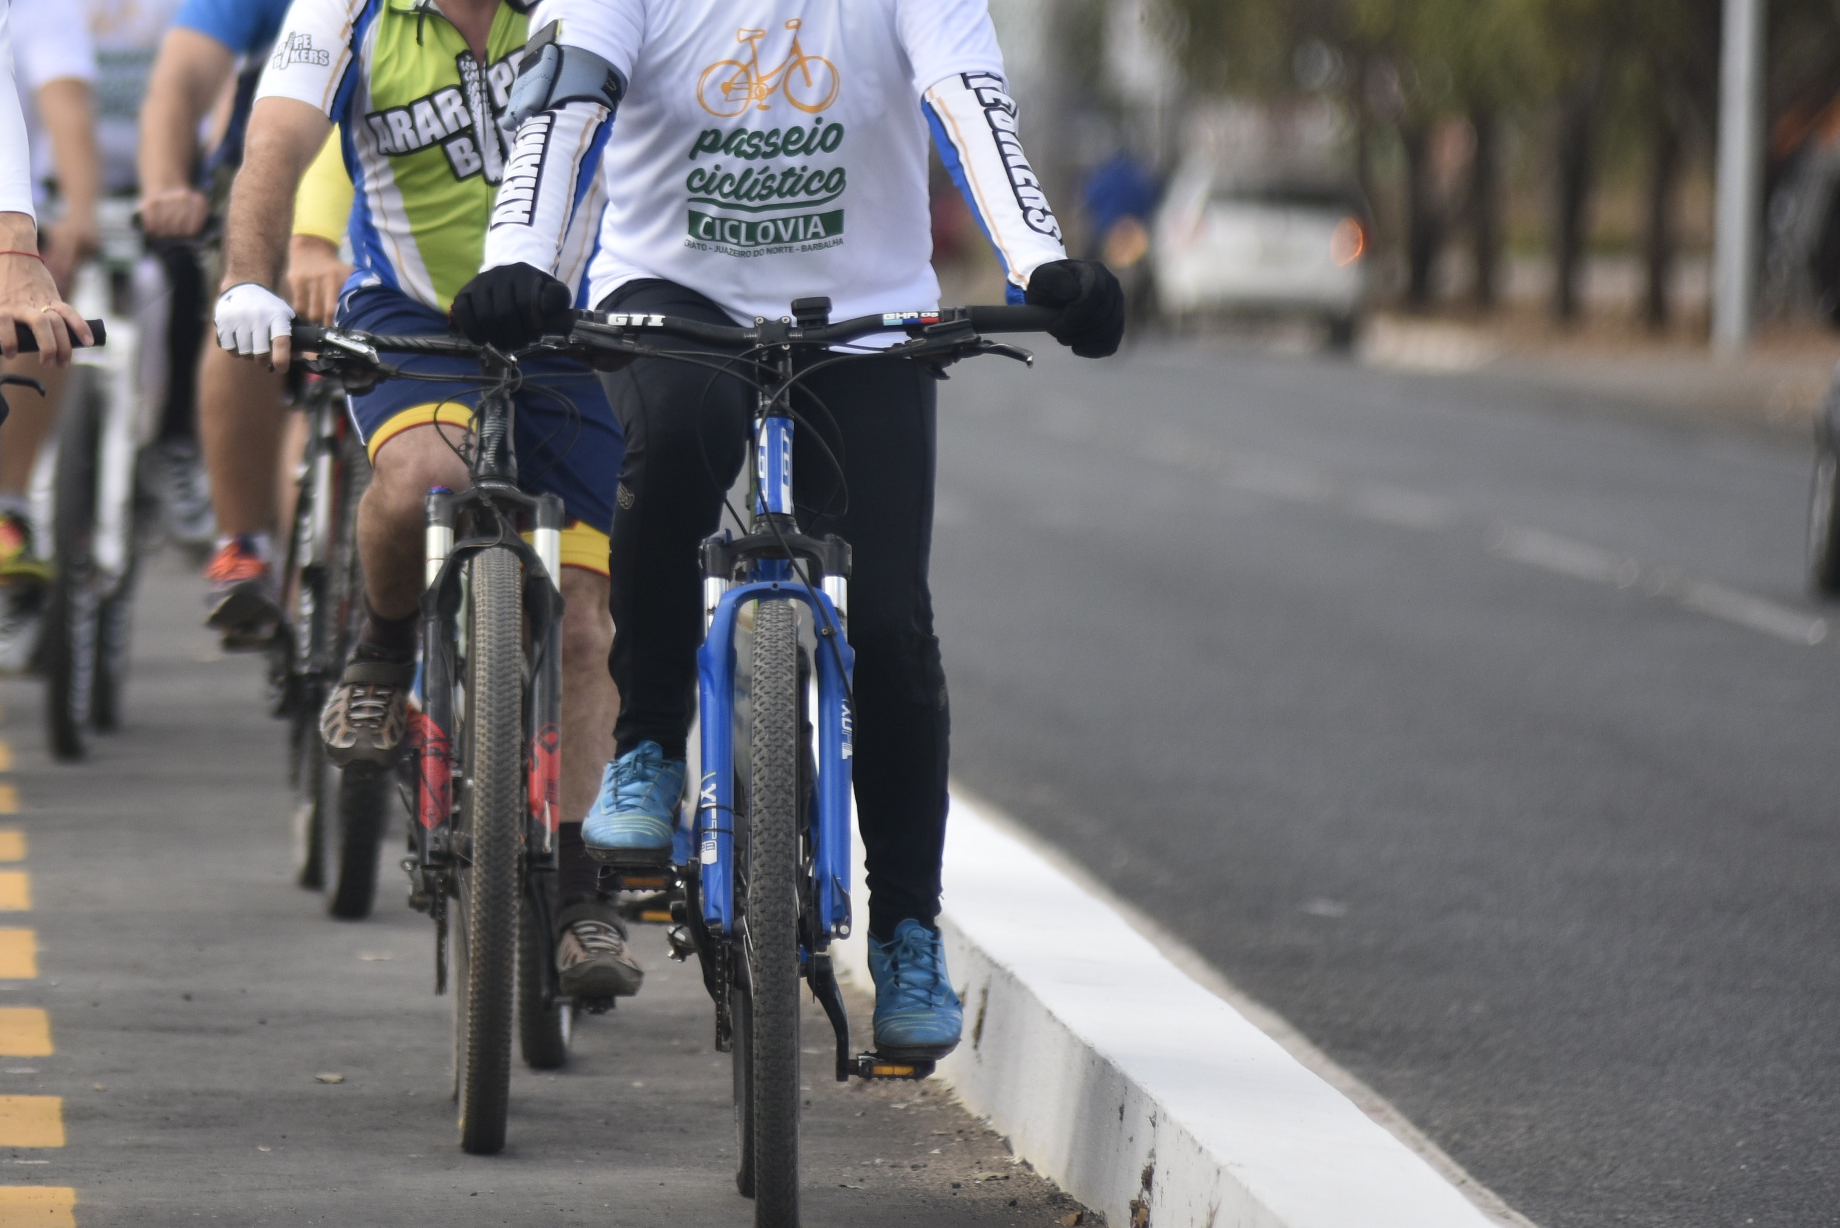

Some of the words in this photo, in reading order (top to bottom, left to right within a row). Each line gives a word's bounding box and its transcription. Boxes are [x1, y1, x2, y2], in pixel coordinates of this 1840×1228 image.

[689, 117, 845, 161] passeio
[686, 164, 847, 203] ciclístico
[699, 215, 827, 246] CICLOVIA
[683, 238, 707, 252] CRATO
[713, 245, 752, 259] JUAZEIRO
[753, 248, 765, 258] DO
[766, 245, 794, 256] NORTE
[801, 237, 844, 252] BARBALHA
[608, 313, 666, 327] GTI
